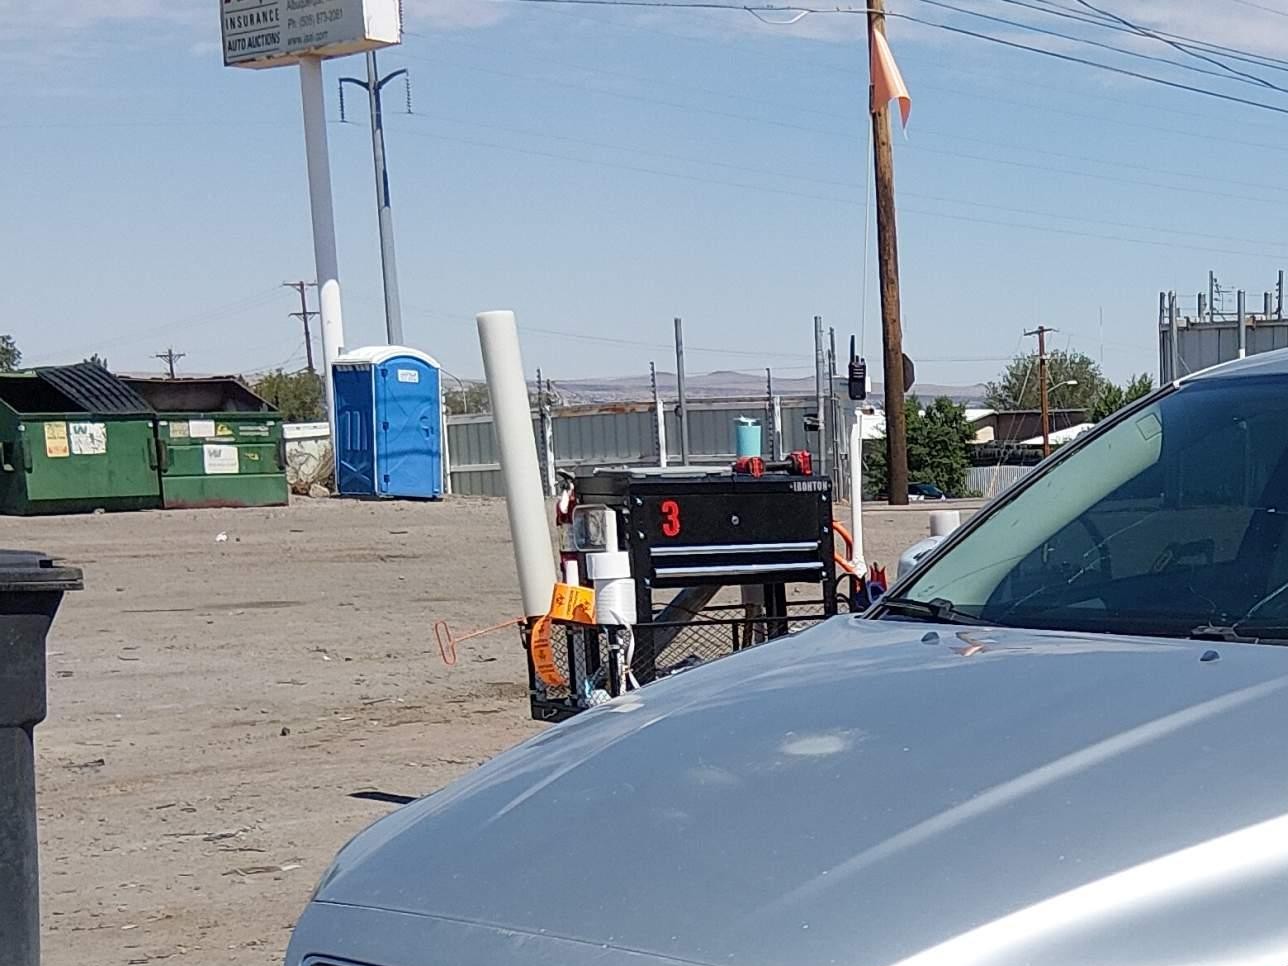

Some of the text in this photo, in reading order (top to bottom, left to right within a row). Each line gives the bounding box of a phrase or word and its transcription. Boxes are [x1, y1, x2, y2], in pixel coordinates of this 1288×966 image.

[225, 8, 280, 30] INSURANCE
[227, 32, 281, 52] AUTO AUCTIONS
[793, 480, 828, 492] IRONTON
[661, 500, 681, 537] 3
